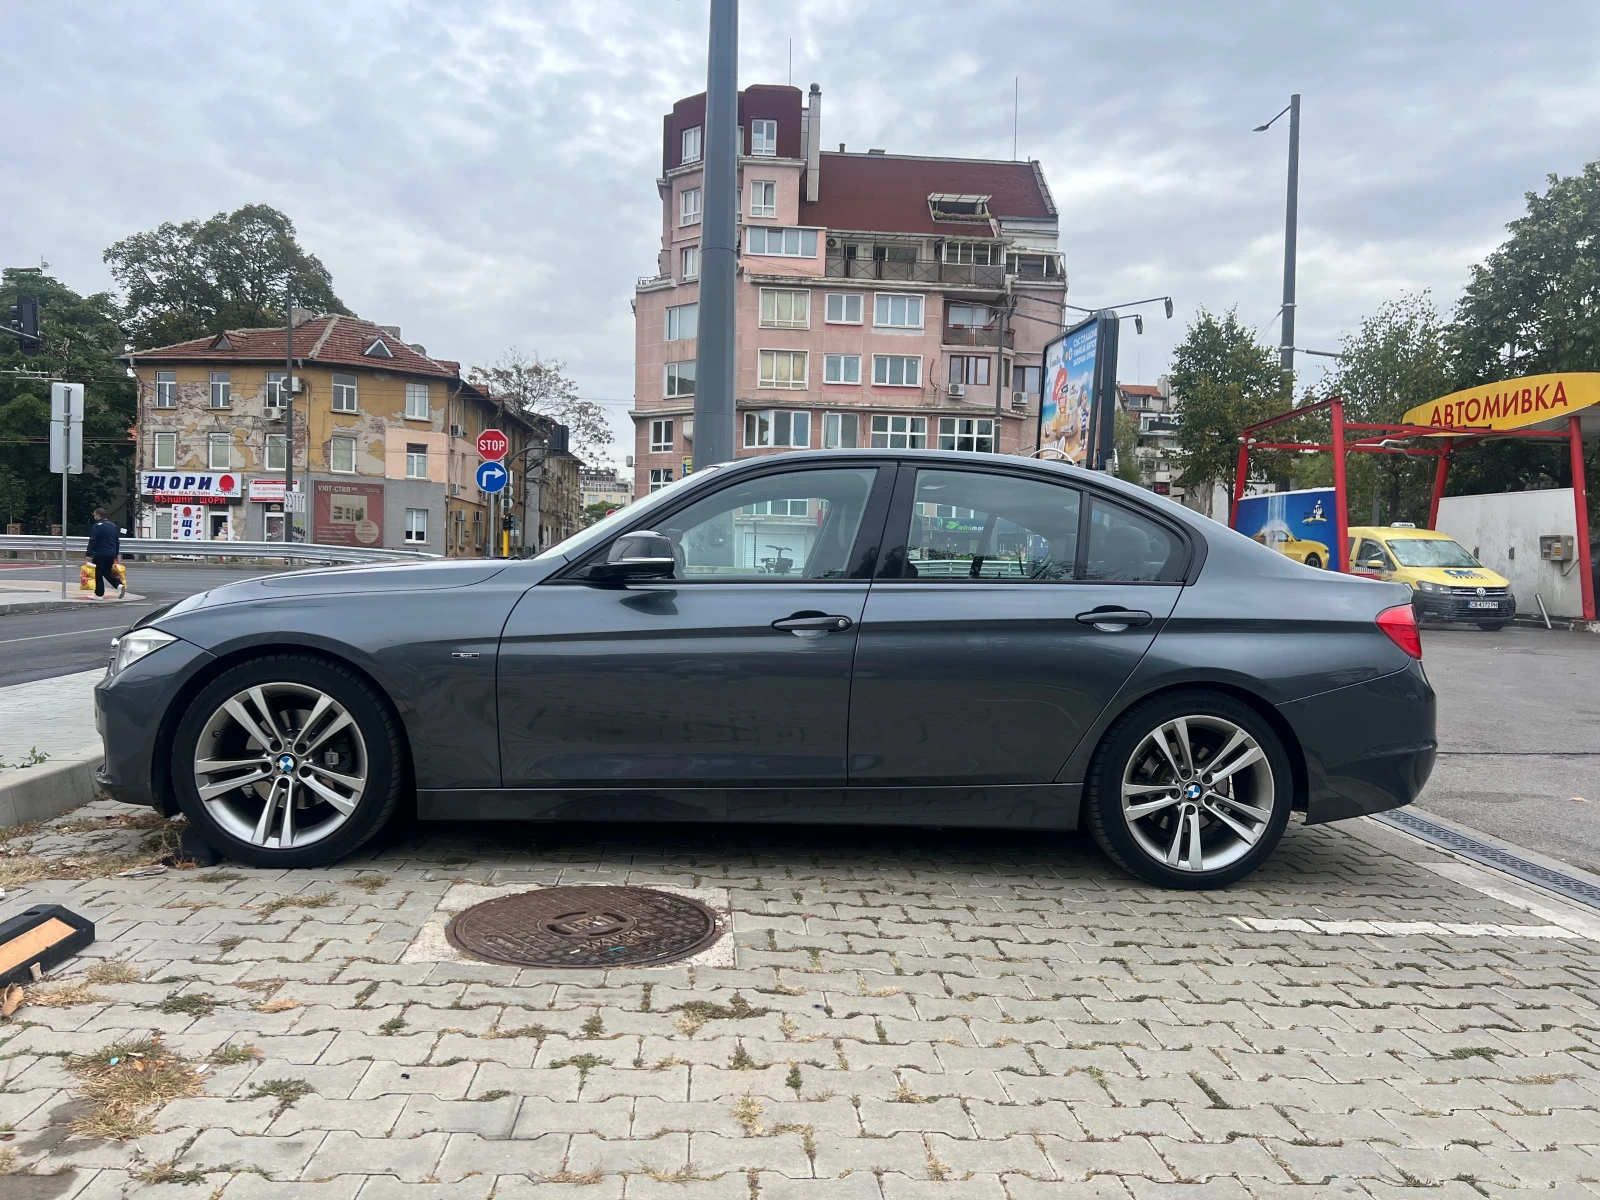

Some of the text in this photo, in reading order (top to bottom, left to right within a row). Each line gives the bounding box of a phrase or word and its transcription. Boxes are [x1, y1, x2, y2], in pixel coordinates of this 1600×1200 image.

[1430, 381, 1568, 426] АВТОМИВКА
[480, 440, 505, 451] STOP
[147, 476, 212, 490] ЩОРИ
[154, 496, 226, 505] ВЪНШНИ ЩОРИ
